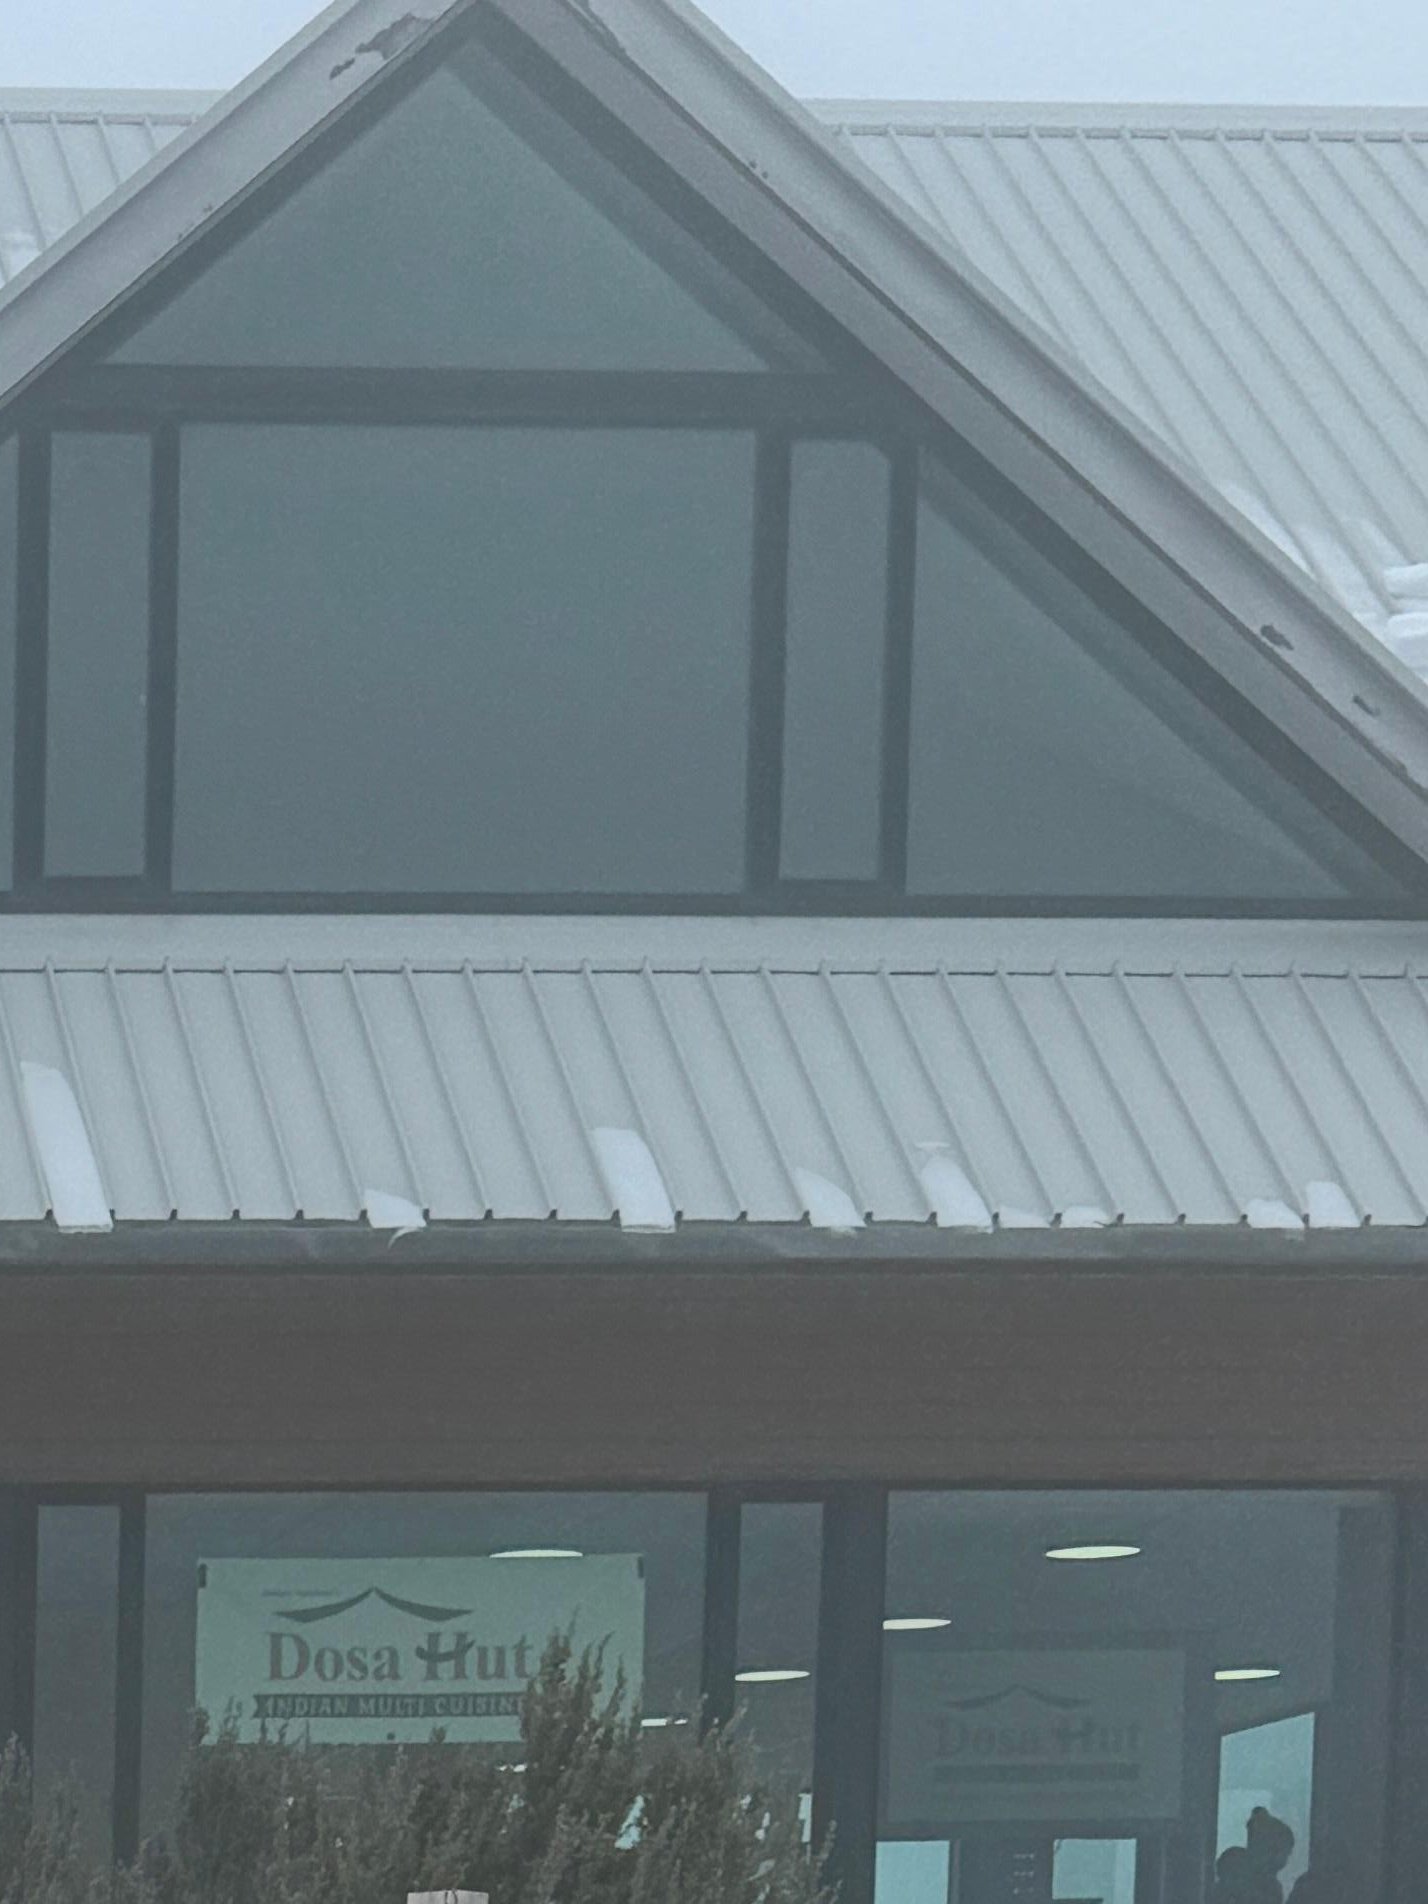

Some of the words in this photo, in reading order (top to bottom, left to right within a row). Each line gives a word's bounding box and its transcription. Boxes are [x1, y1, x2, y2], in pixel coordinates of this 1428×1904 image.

[268, 1632, 403, 1681] Dosa
[415, 1631, 534, 1680] Hut
[264, 1696, 349, 1716] INDIAN
[357, 1696, 426, 1716] MULTI
